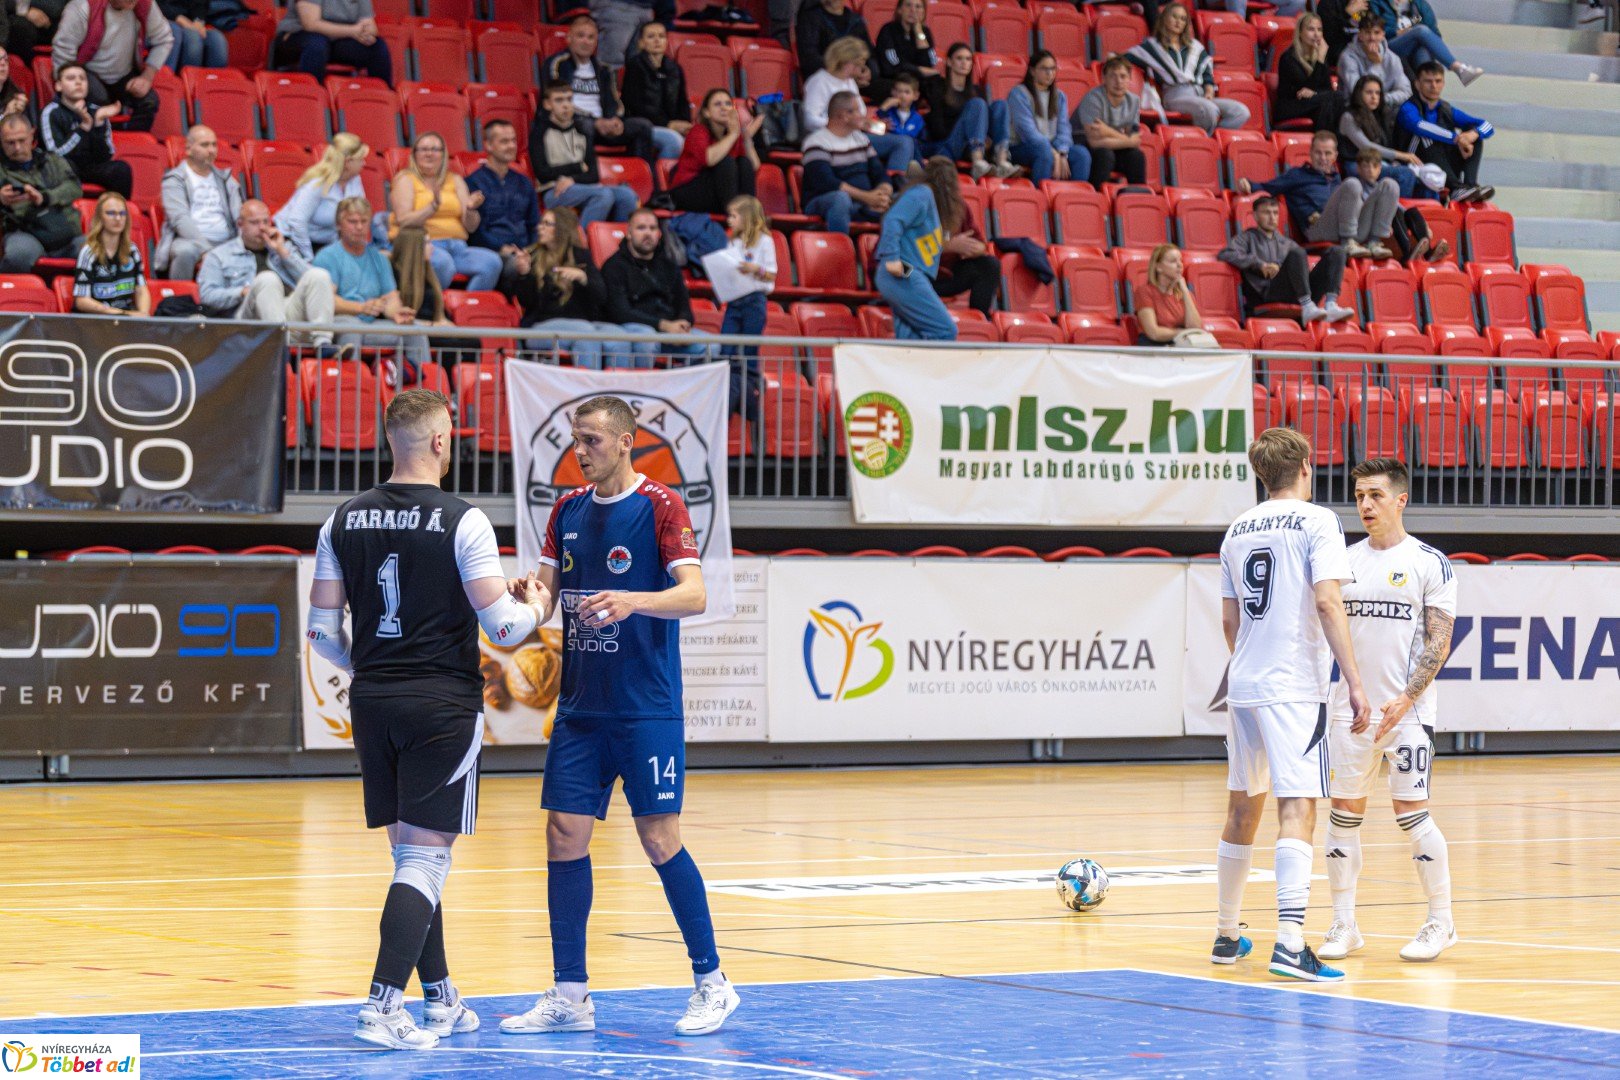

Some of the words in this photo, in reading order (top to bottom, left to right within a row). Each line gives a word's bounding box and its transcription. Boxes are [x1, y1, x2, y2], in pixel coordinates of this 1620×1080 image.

[0, 339, 196, 431] 90
[545, 400, 688, 451] FSAL
[940, 396, 1247, 454] mlsz.hu
[939, 458, 1013, 481] Magyar
[1023, 459, 1135, 482] Labdarúgó
[1145, 460, 1248, 482] Szövetség
[345, 505, 421, 530] FARAGÓ
[425, 508, 445, 533] Á.
[1231, 511, 1306, 538] KRAJNYÁK
[376, 553, 402, 639] 1
[1243, 547, 1276, 621] 9
[178, 604, 281, 657] 90
[567, 639, 619, 652] STUDIO
[908, 631, 1156, 671] NYÍREGYHÁZA
[204, 683, 271, 702] KFT
[908, 680, 956, 694] MEGYEI
[960, 679, 993, 694] JOGÚ
[998, 678, 1038, 693] VÁROS
[1042, 678, 1157, 693] ÖNKORMÁNYZATA
[648, 756, 677, 785] 14
[1396, 744, 1429, 775] 30
